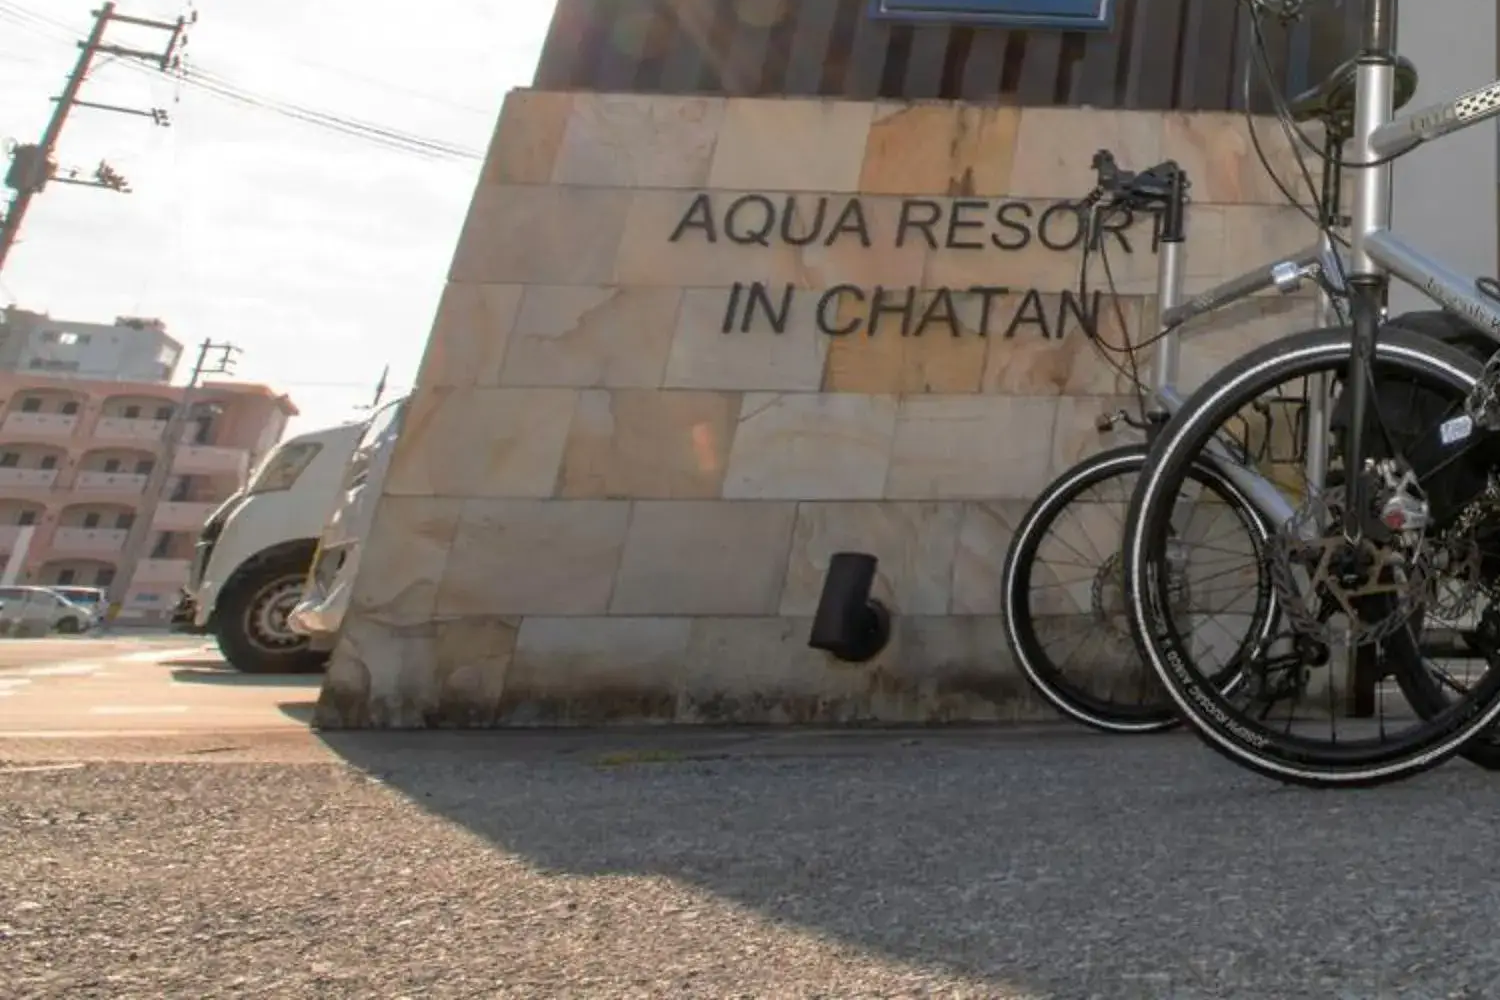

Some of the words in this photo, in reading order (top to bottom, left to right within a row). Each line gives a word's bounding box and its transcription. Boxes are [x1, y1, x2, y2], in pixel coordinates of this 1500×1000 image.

[669, 193, 873, 250] AQUA
[722, 281, 794, 334] IN
[816, 284, 1102, 340] CHATAN
